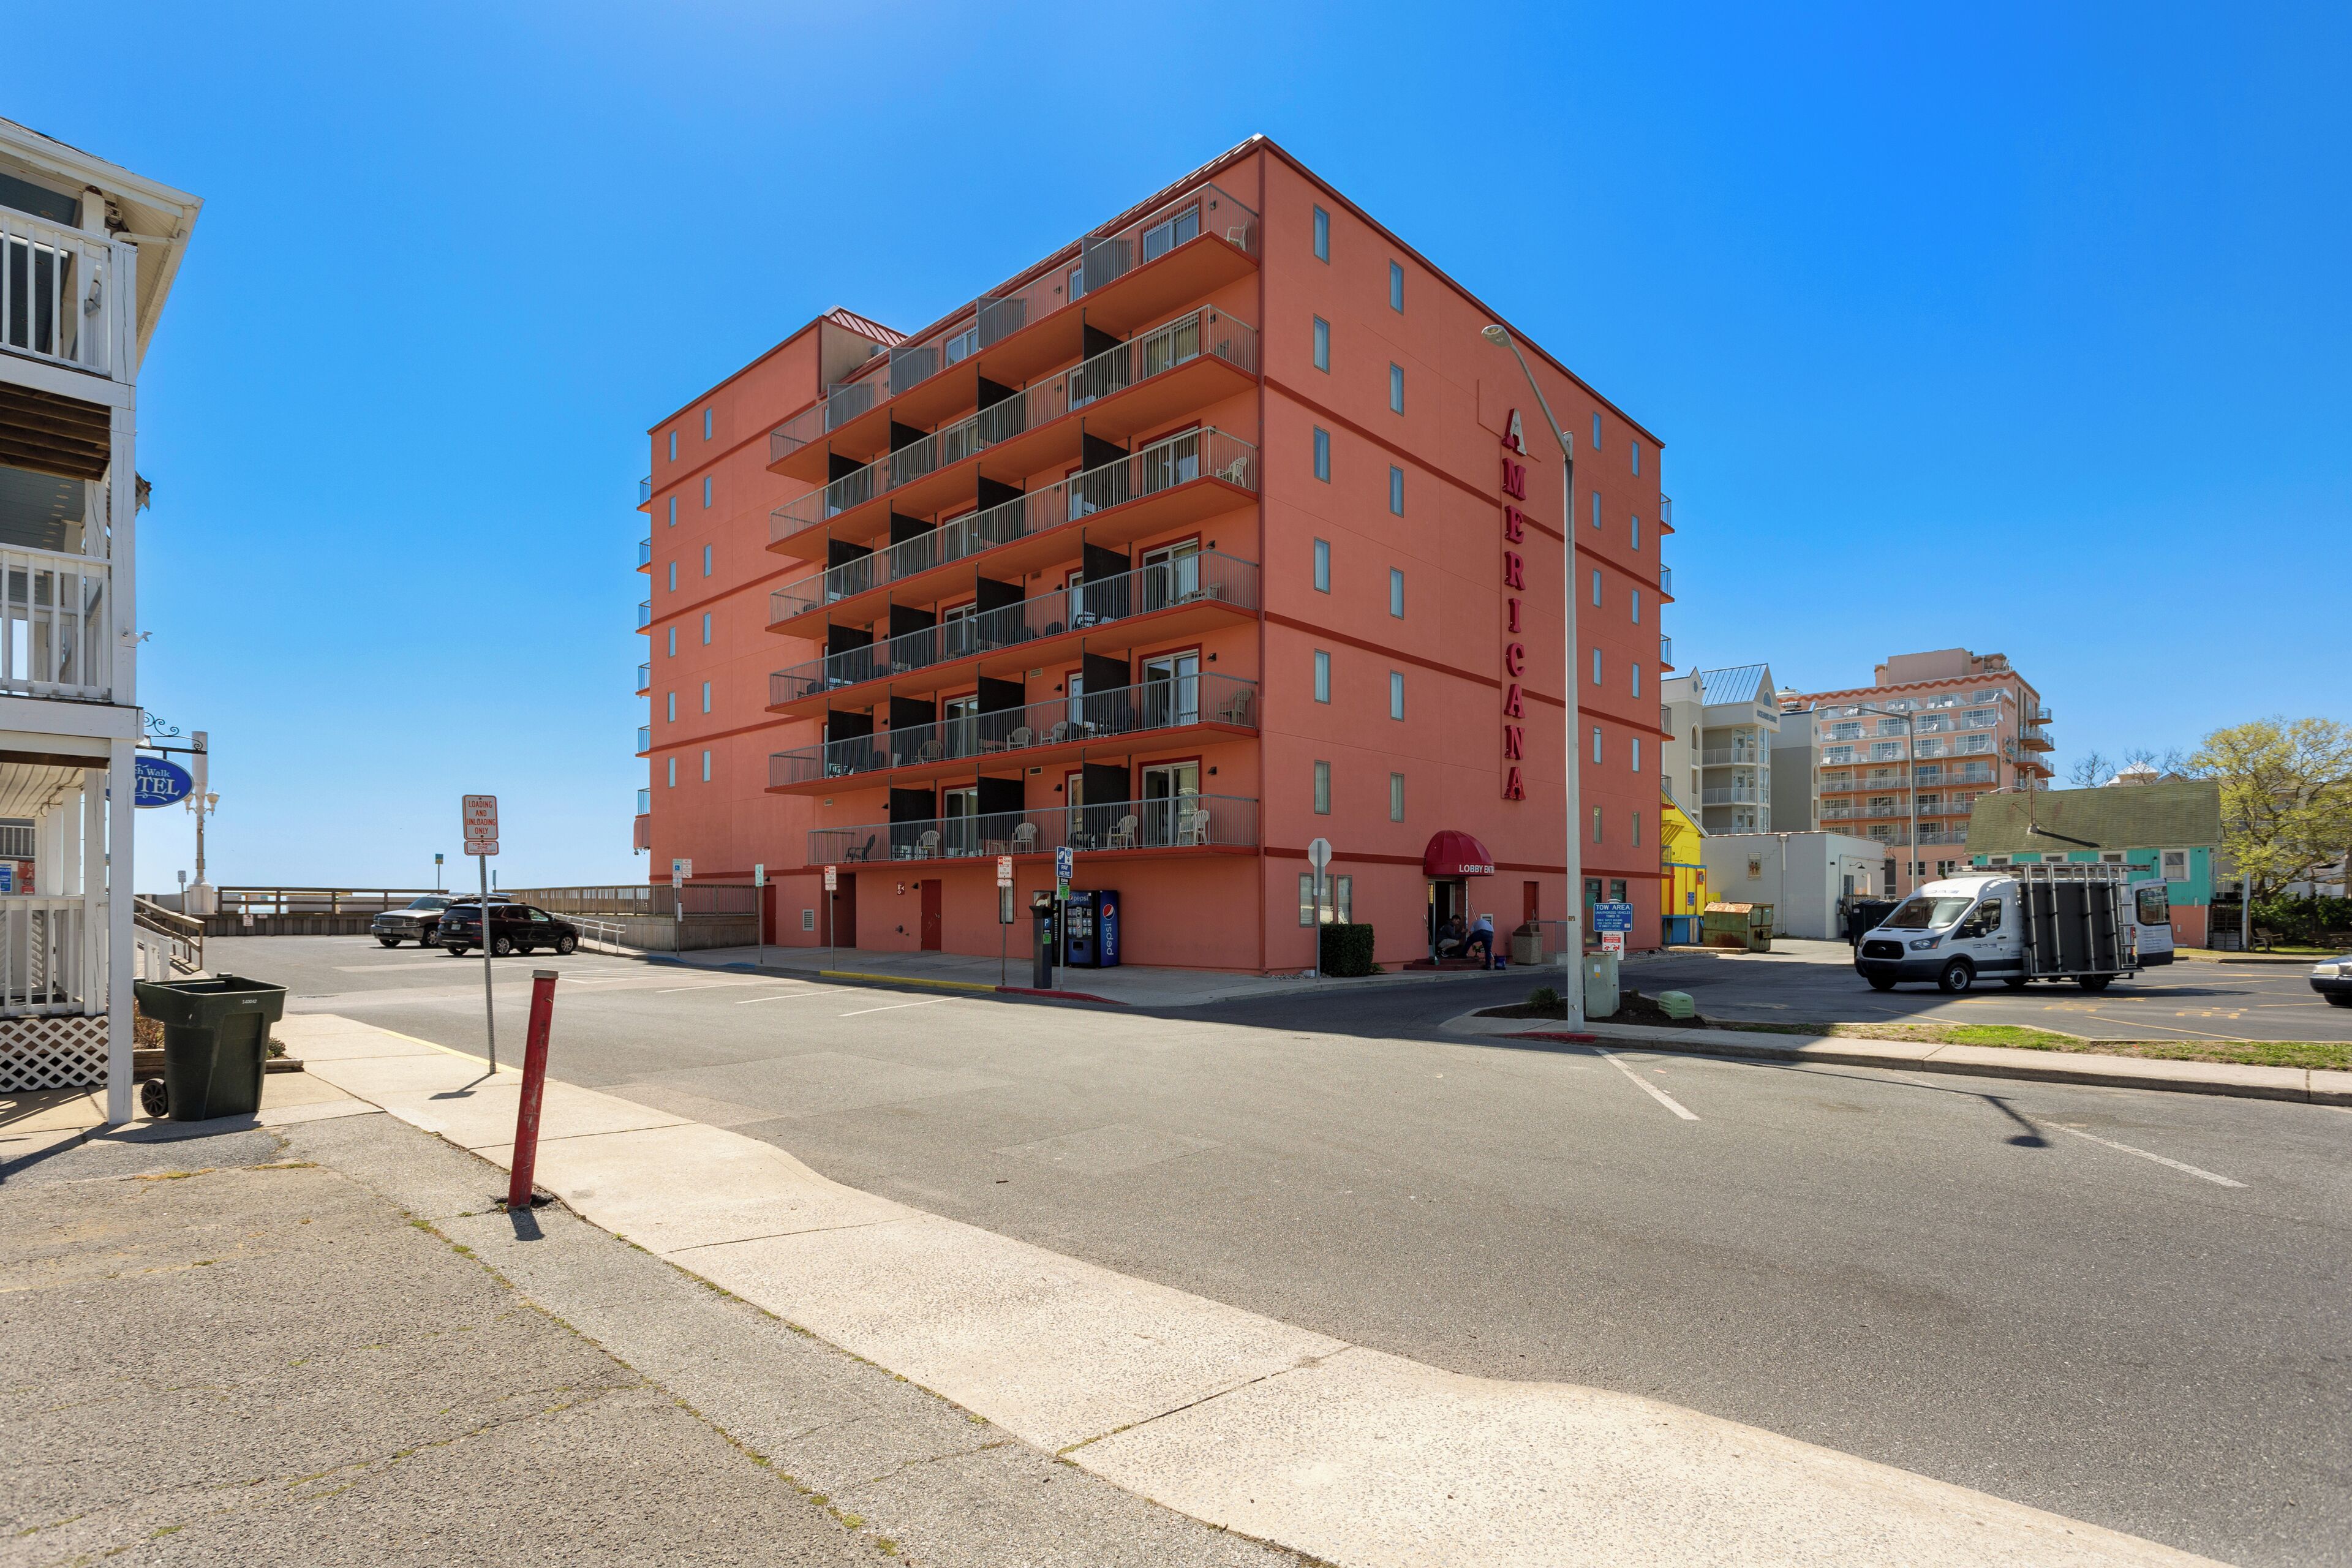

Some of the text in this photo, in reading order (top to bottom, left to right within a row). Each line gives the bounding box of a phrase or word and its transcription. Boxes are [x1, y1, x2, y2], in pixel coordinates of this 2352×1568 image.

[1501, 407, 1527, 801] AMERICANA
[146, 768, 171, 777] Walk
[135, 775, 180, 796] TEL
[1459, 864, 1483, 873] LOBBY
[1104, 924, 1114, 956] pepsi
